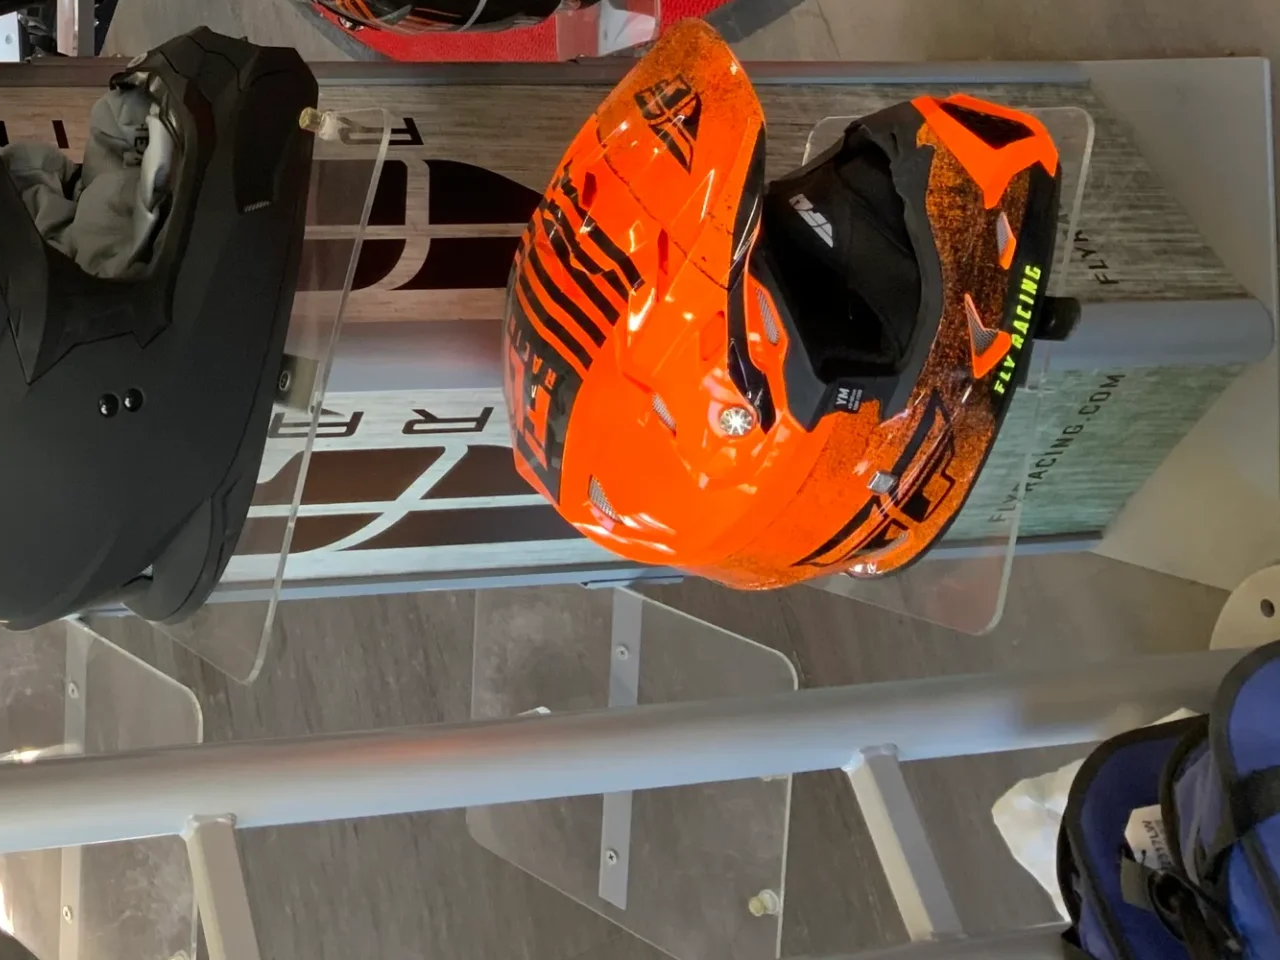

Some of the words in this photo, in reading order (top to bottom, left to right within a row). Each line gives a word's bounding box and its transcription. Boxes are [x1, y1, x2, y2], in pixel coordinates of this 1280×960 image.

[510, 315, 557, 390] RACIN
[994, 354, 1016, 394] FLY
[1011, 264, 1042, 349] RACING
[836, 388, 850, 404] YM
